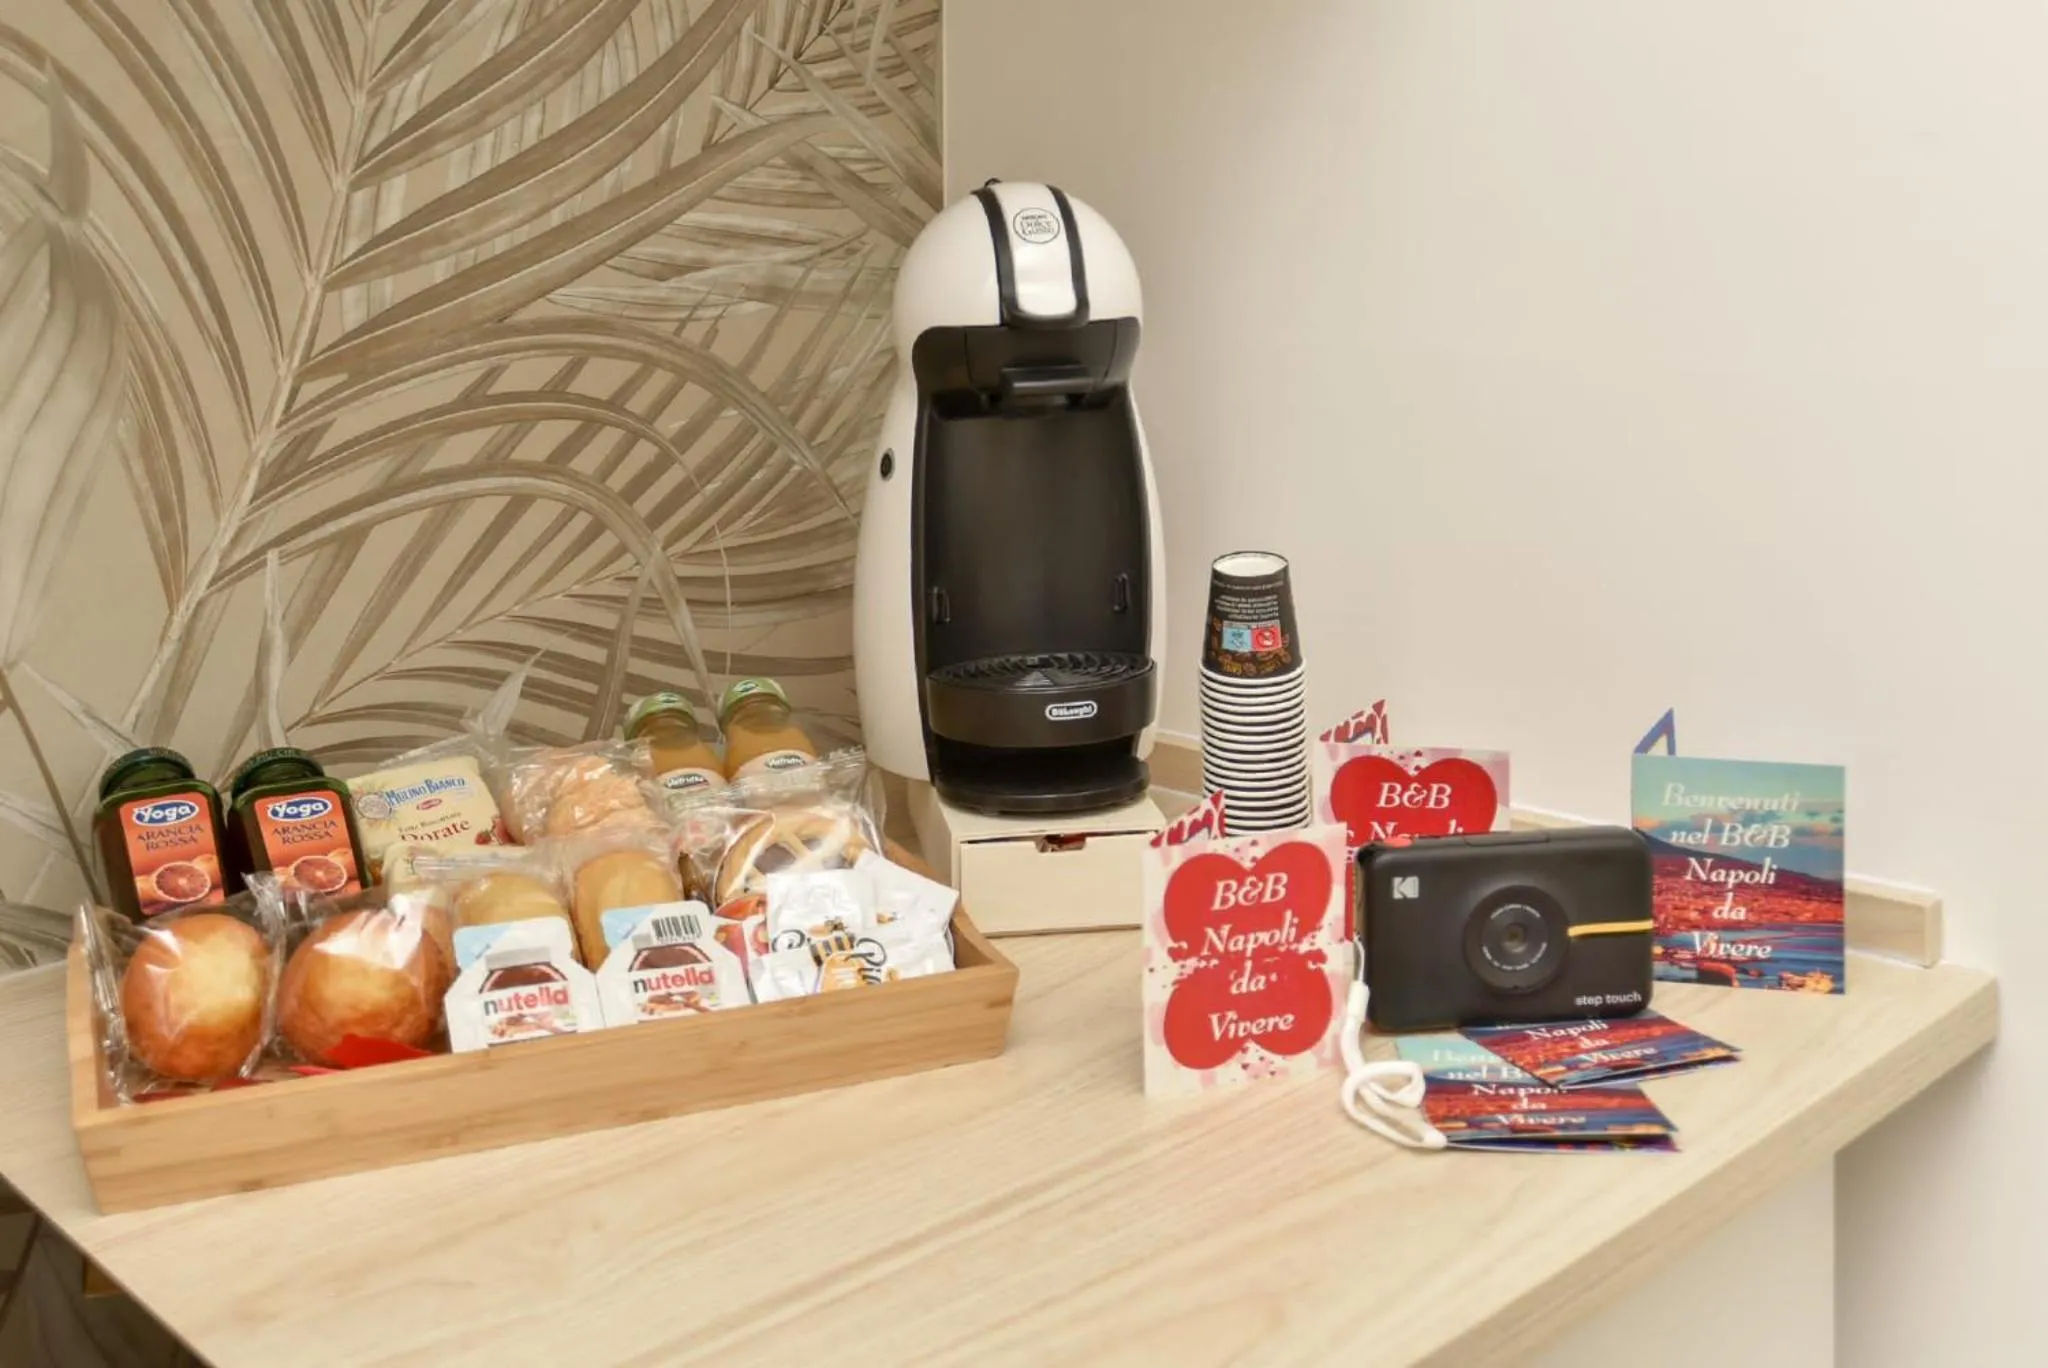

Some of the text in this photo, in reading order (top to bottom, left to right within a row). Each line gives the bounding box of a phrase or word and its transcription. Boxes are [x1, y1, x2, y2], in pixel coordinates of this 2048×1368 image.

[1376, 781, 1452, 809] B&B
[1661, 782, 1800, 812] Benvenuti
[133, 805, 192, 823] Yoga
[268, 802, 325, 818] Yoga
[136, 823, 204, 841] ARANCIA
[272, 819, 337, 835] ARANCIA
[281, 830, 333, 845] ROSSA
[1670, 818, 1792, 849] nel B&B
[145, 835, 198, 851] ROSSA
[1684, 856, 1778, 888] Napoli
[1210, 872, 1288, 911] B&B
[1712, 892, 1747, 920] da
[1199, 909, 1300, 957] Napoli
[1692, 931, 1773, 958] Vivere
[633, 966, 715, 994] nutella
[1230, 960, 1266, 995] da
[484, 986, 569, 1016] nutella
[1574, 990, 1642, 1008] step touch
[1208, 1011, 1295, 1041] Vivere
[1524, 1020, 1609, 1040] Napoli
[1579, 1036, 1609, 1050] da
[1512, 1096, 1548, 1110] da
